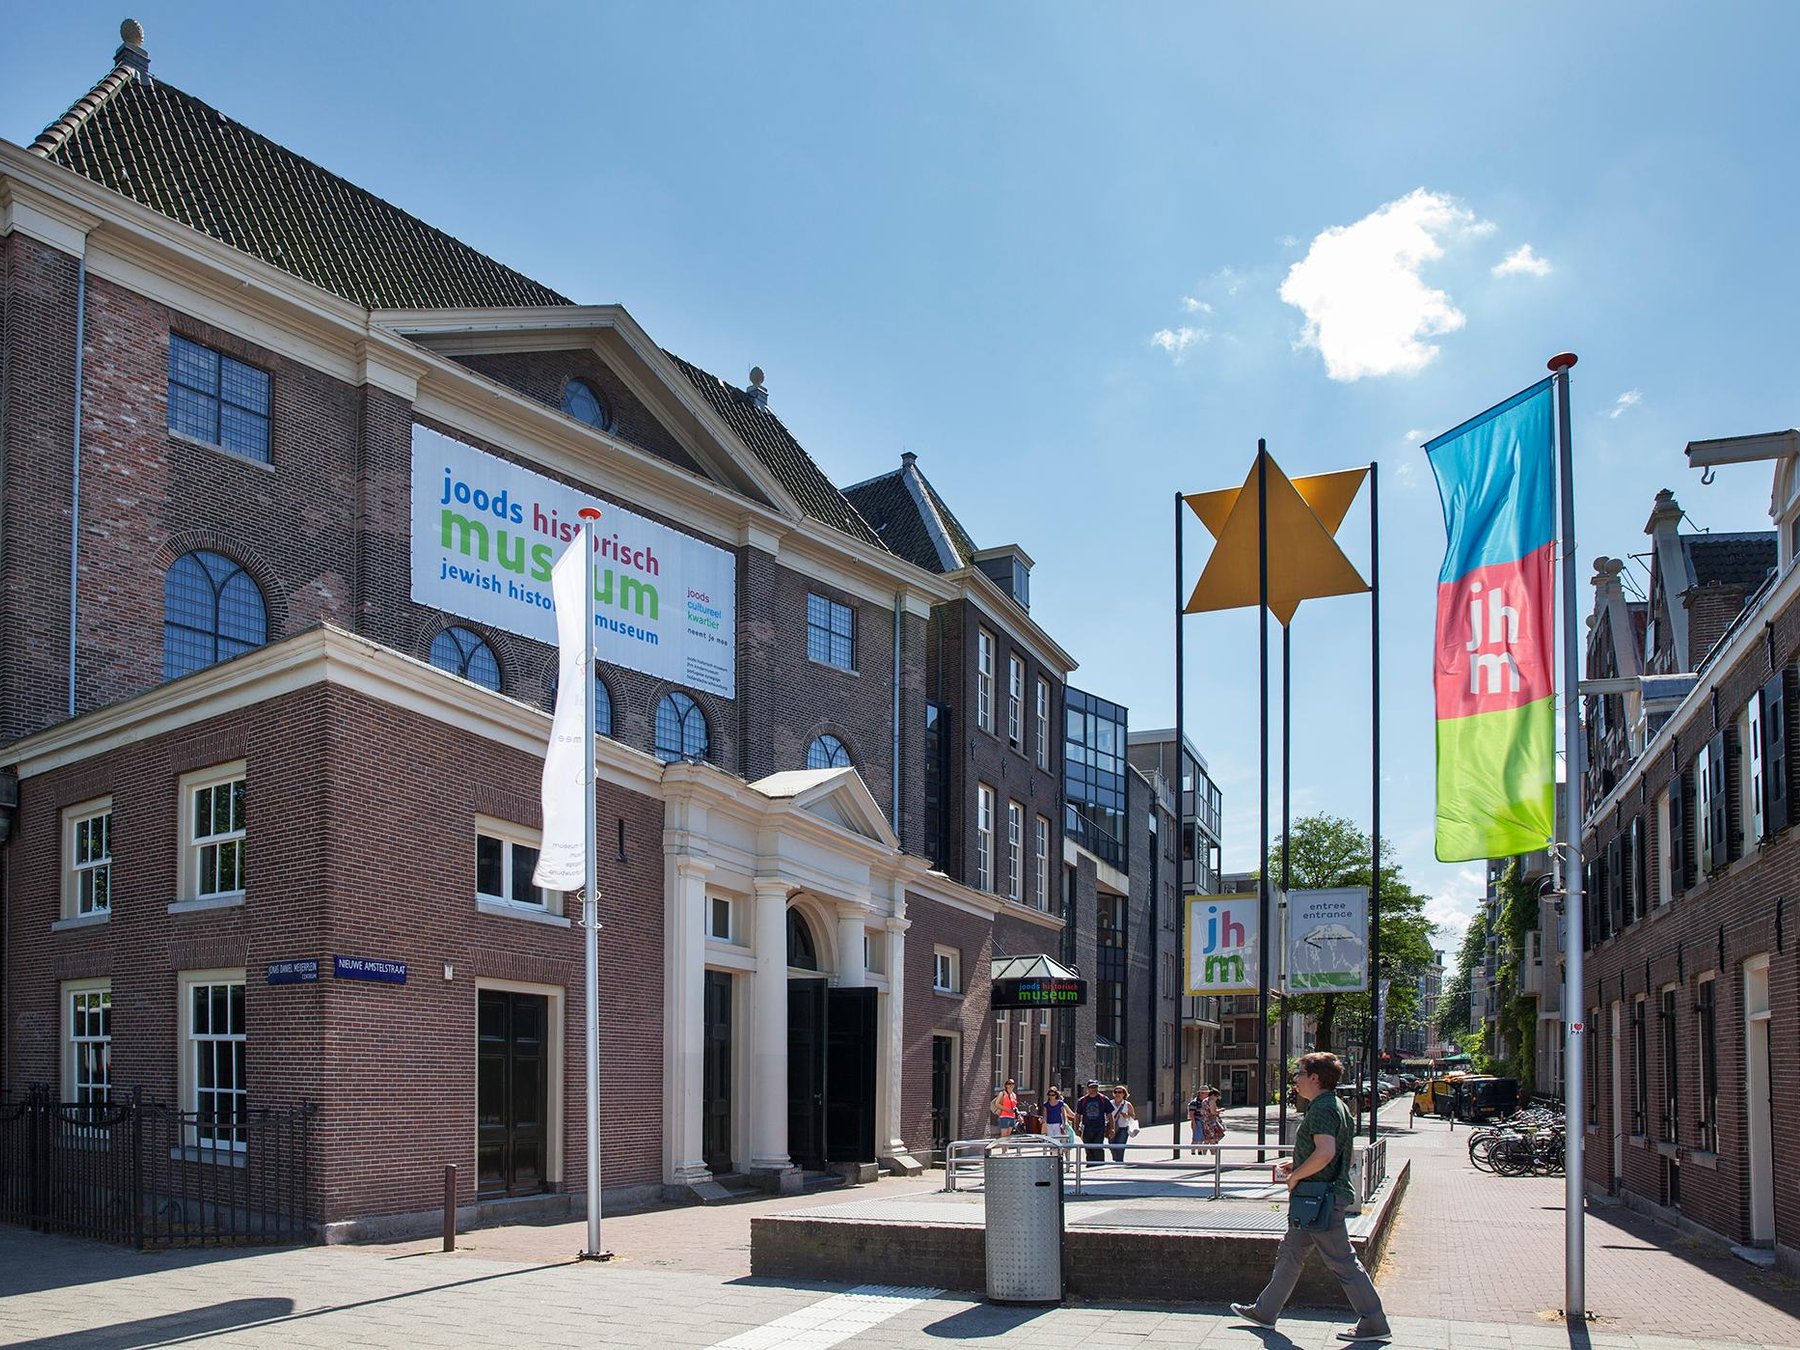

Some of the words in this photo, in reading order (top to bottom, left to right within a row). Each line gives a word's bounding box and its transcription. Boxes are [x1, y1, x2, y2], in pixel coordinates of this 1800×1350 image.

[441, 467, 523, 524] joods
[441, 509, 659, 621] musum
[440, 557, 502, 594] jewish
[595, 614, 658, 645] museum
[687, 587, 710, 603] joods
[687, 601, 722, 619] cultureel
[687, 610, 720, 630] kwartier
[1466, 582, 1520, 652] jh
[1470, 652, 1520, 694] m
[1303, 911, 1353, 920] entrance
[1309, 902, 1346, 911] entree
[1202, 905, 1246, 954] jh
[338, 958, 363, 971] NIEUWE
[364, 961, 406, 975] AMSTELSTRAAT
[1205, 954, 1245, 983] m
[1018, 991, 1078, 1001] museum
[1019, 982, 1041, 991] joods
[1042, 981, 1079, 990] historisch
